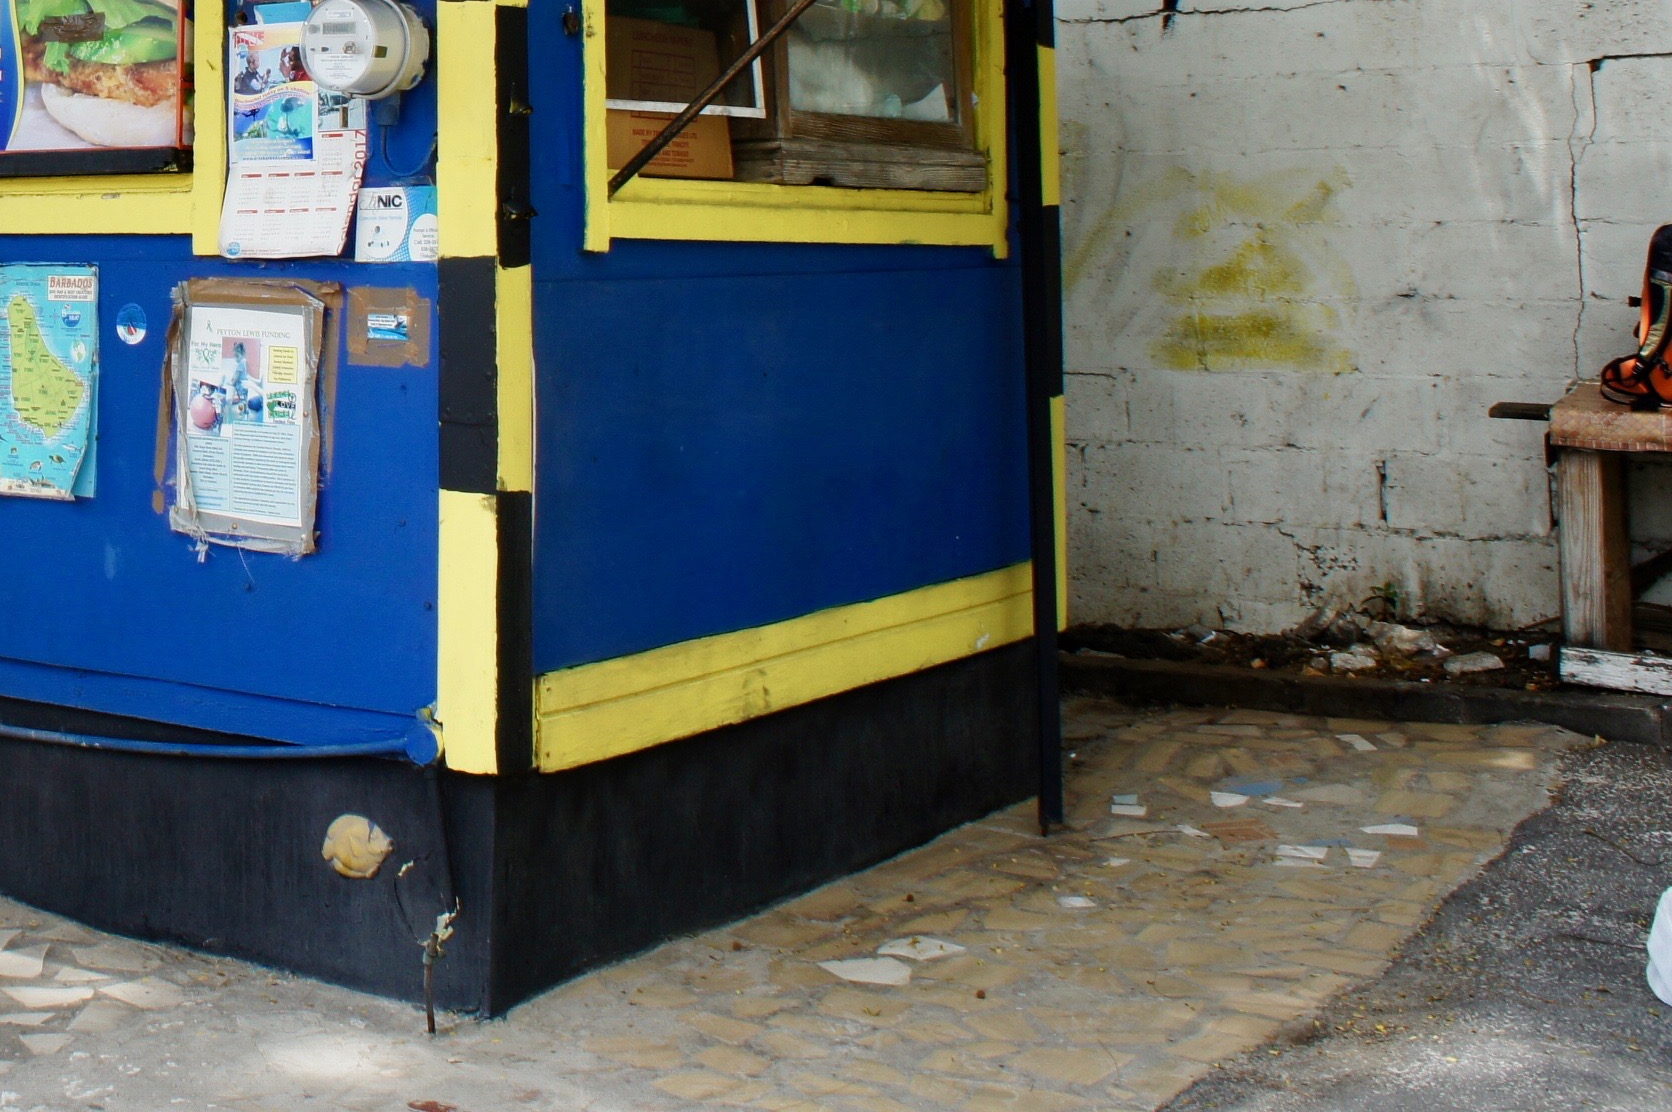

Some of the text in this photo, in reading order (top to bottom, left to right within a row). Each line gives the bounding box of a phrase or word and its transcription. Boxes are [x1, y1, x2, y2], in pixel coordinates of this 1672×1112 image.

[354, 129, 367, 171] 2017
[50, 276, 93, 288] BARBADOS
[216, 328, 241, 336] PEYTON
[261, 330, 291, 339] FUNDING
